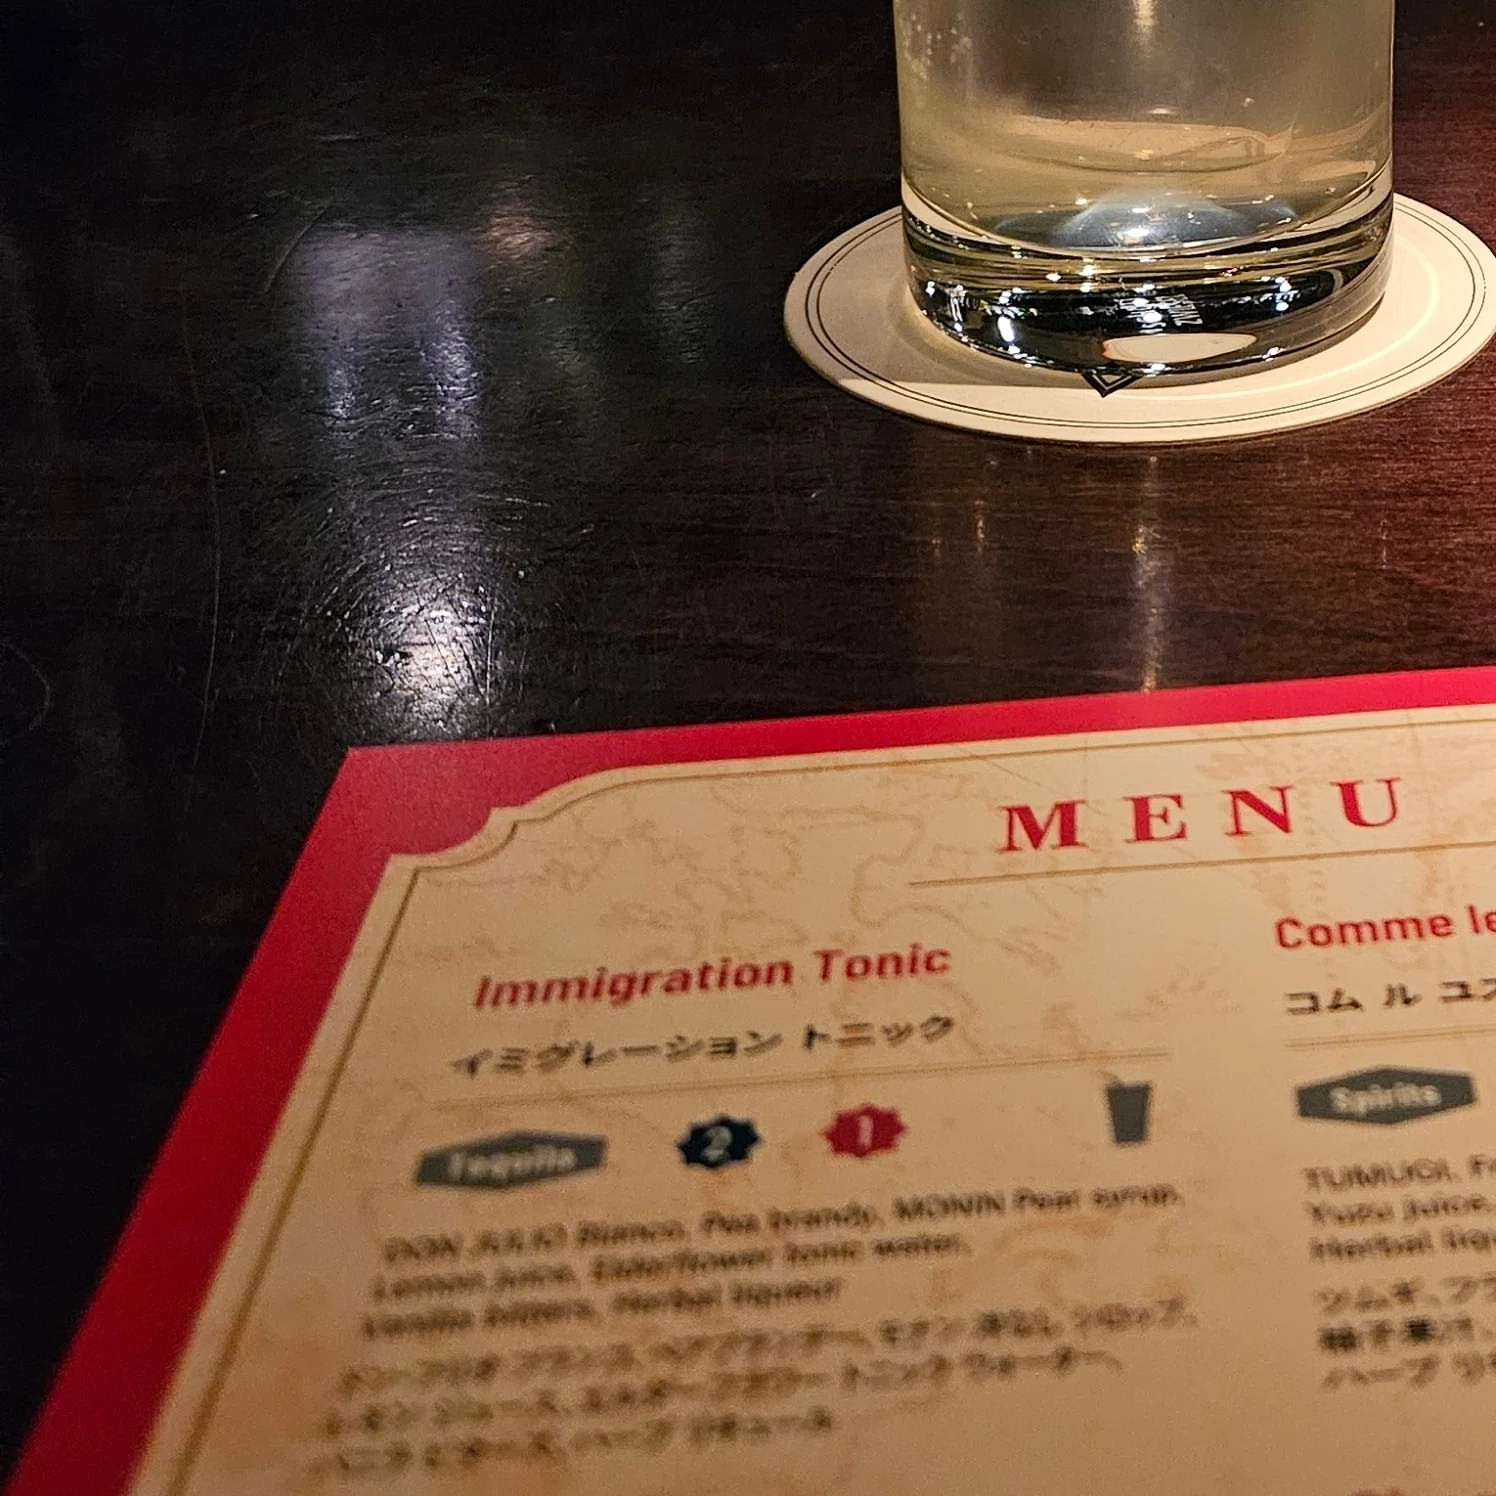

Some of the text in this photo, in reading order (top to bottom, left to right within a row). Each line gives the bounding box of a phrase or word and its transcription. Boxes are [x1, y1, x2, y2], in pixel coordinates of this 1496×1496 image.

[996, 777, 1400, 853] MENU
[1275, 915, 1453, 950] Comme
[474, 942, 952, 1008] Immigration Tonic
[1329, 1080, 1443, 1118] Spirits
[703, 1124, 733, 1163] 2
[857, 1114, 874, 1150] 1
